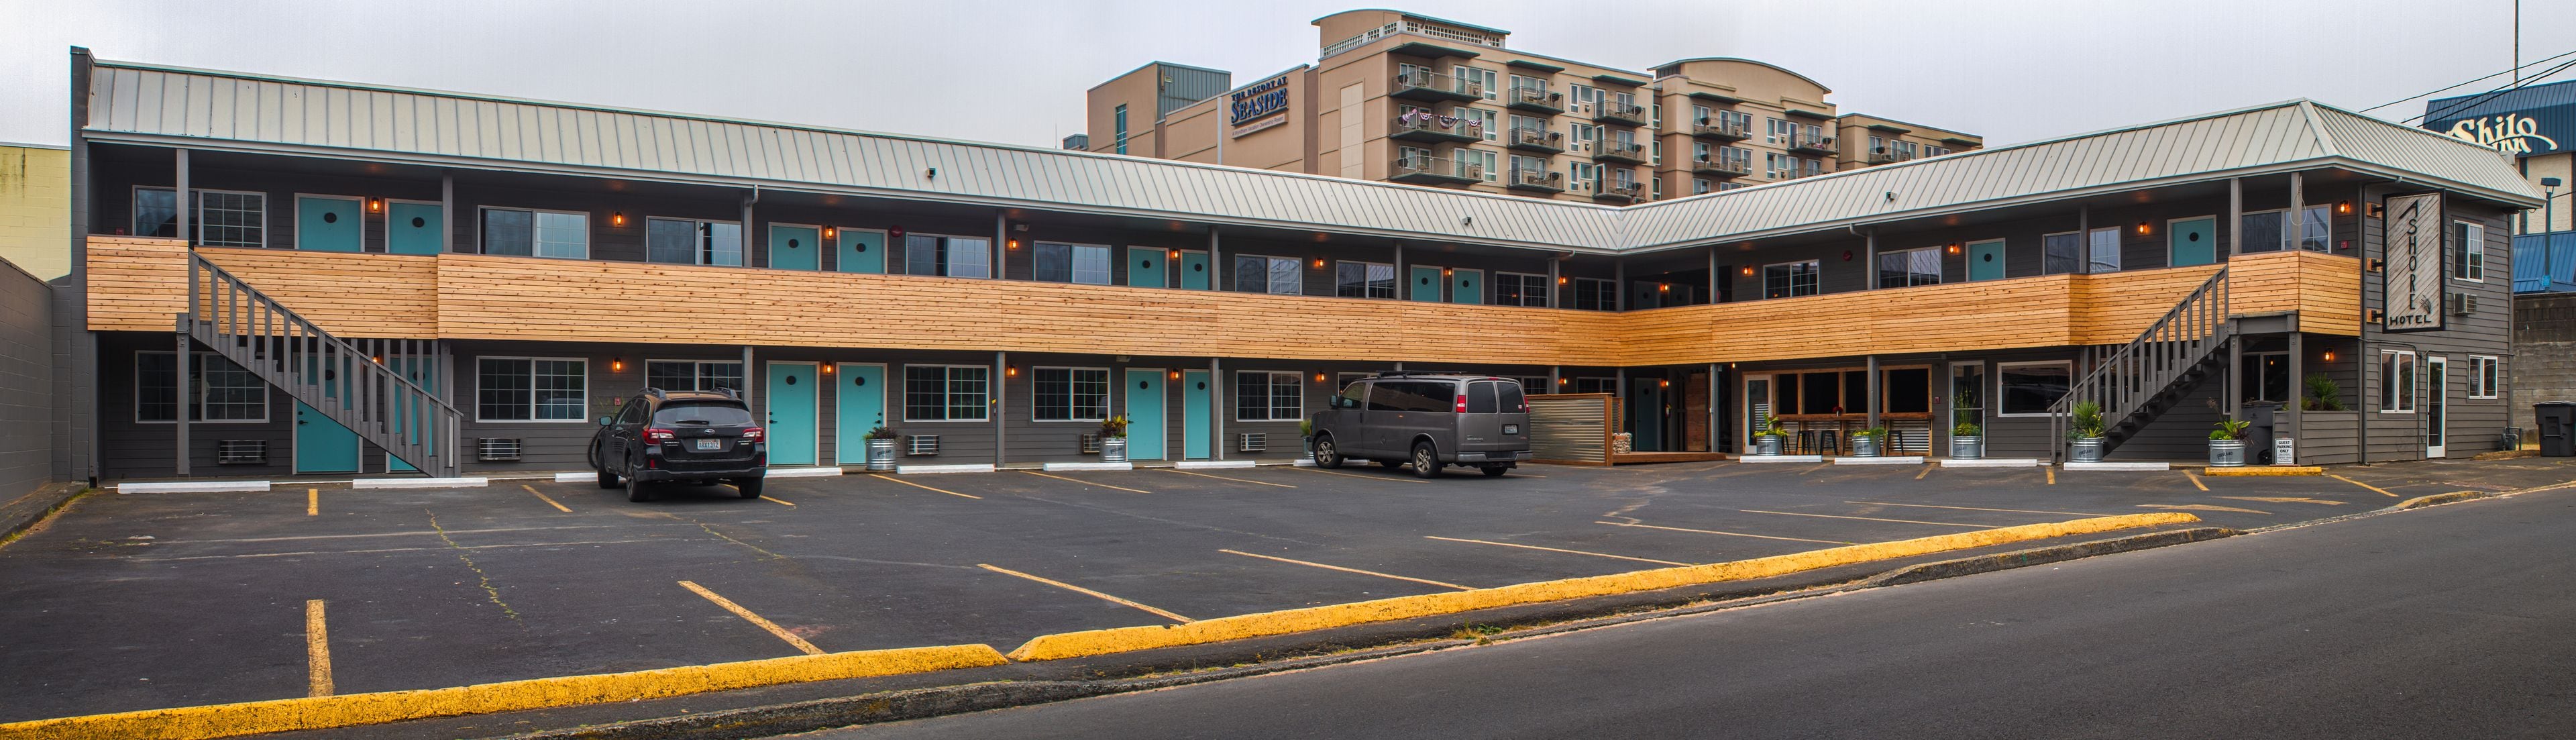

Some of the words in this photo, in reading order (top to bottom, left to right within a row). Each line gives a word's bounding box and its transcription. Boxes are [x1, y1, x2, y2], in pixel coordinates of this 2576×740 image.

[1231, 91, 1245, 101] THE
[1247, 80, 1275, 95] RESORT
[1277, 76, 1287, 86] AT
[1231, 88, 1287, 123] SEASIDE
[2446, 113, 2557, 150] Shilo
[2398, 199, 2419, 310] ASHORE
[2390, 314, 2432, 325] HOTEL
